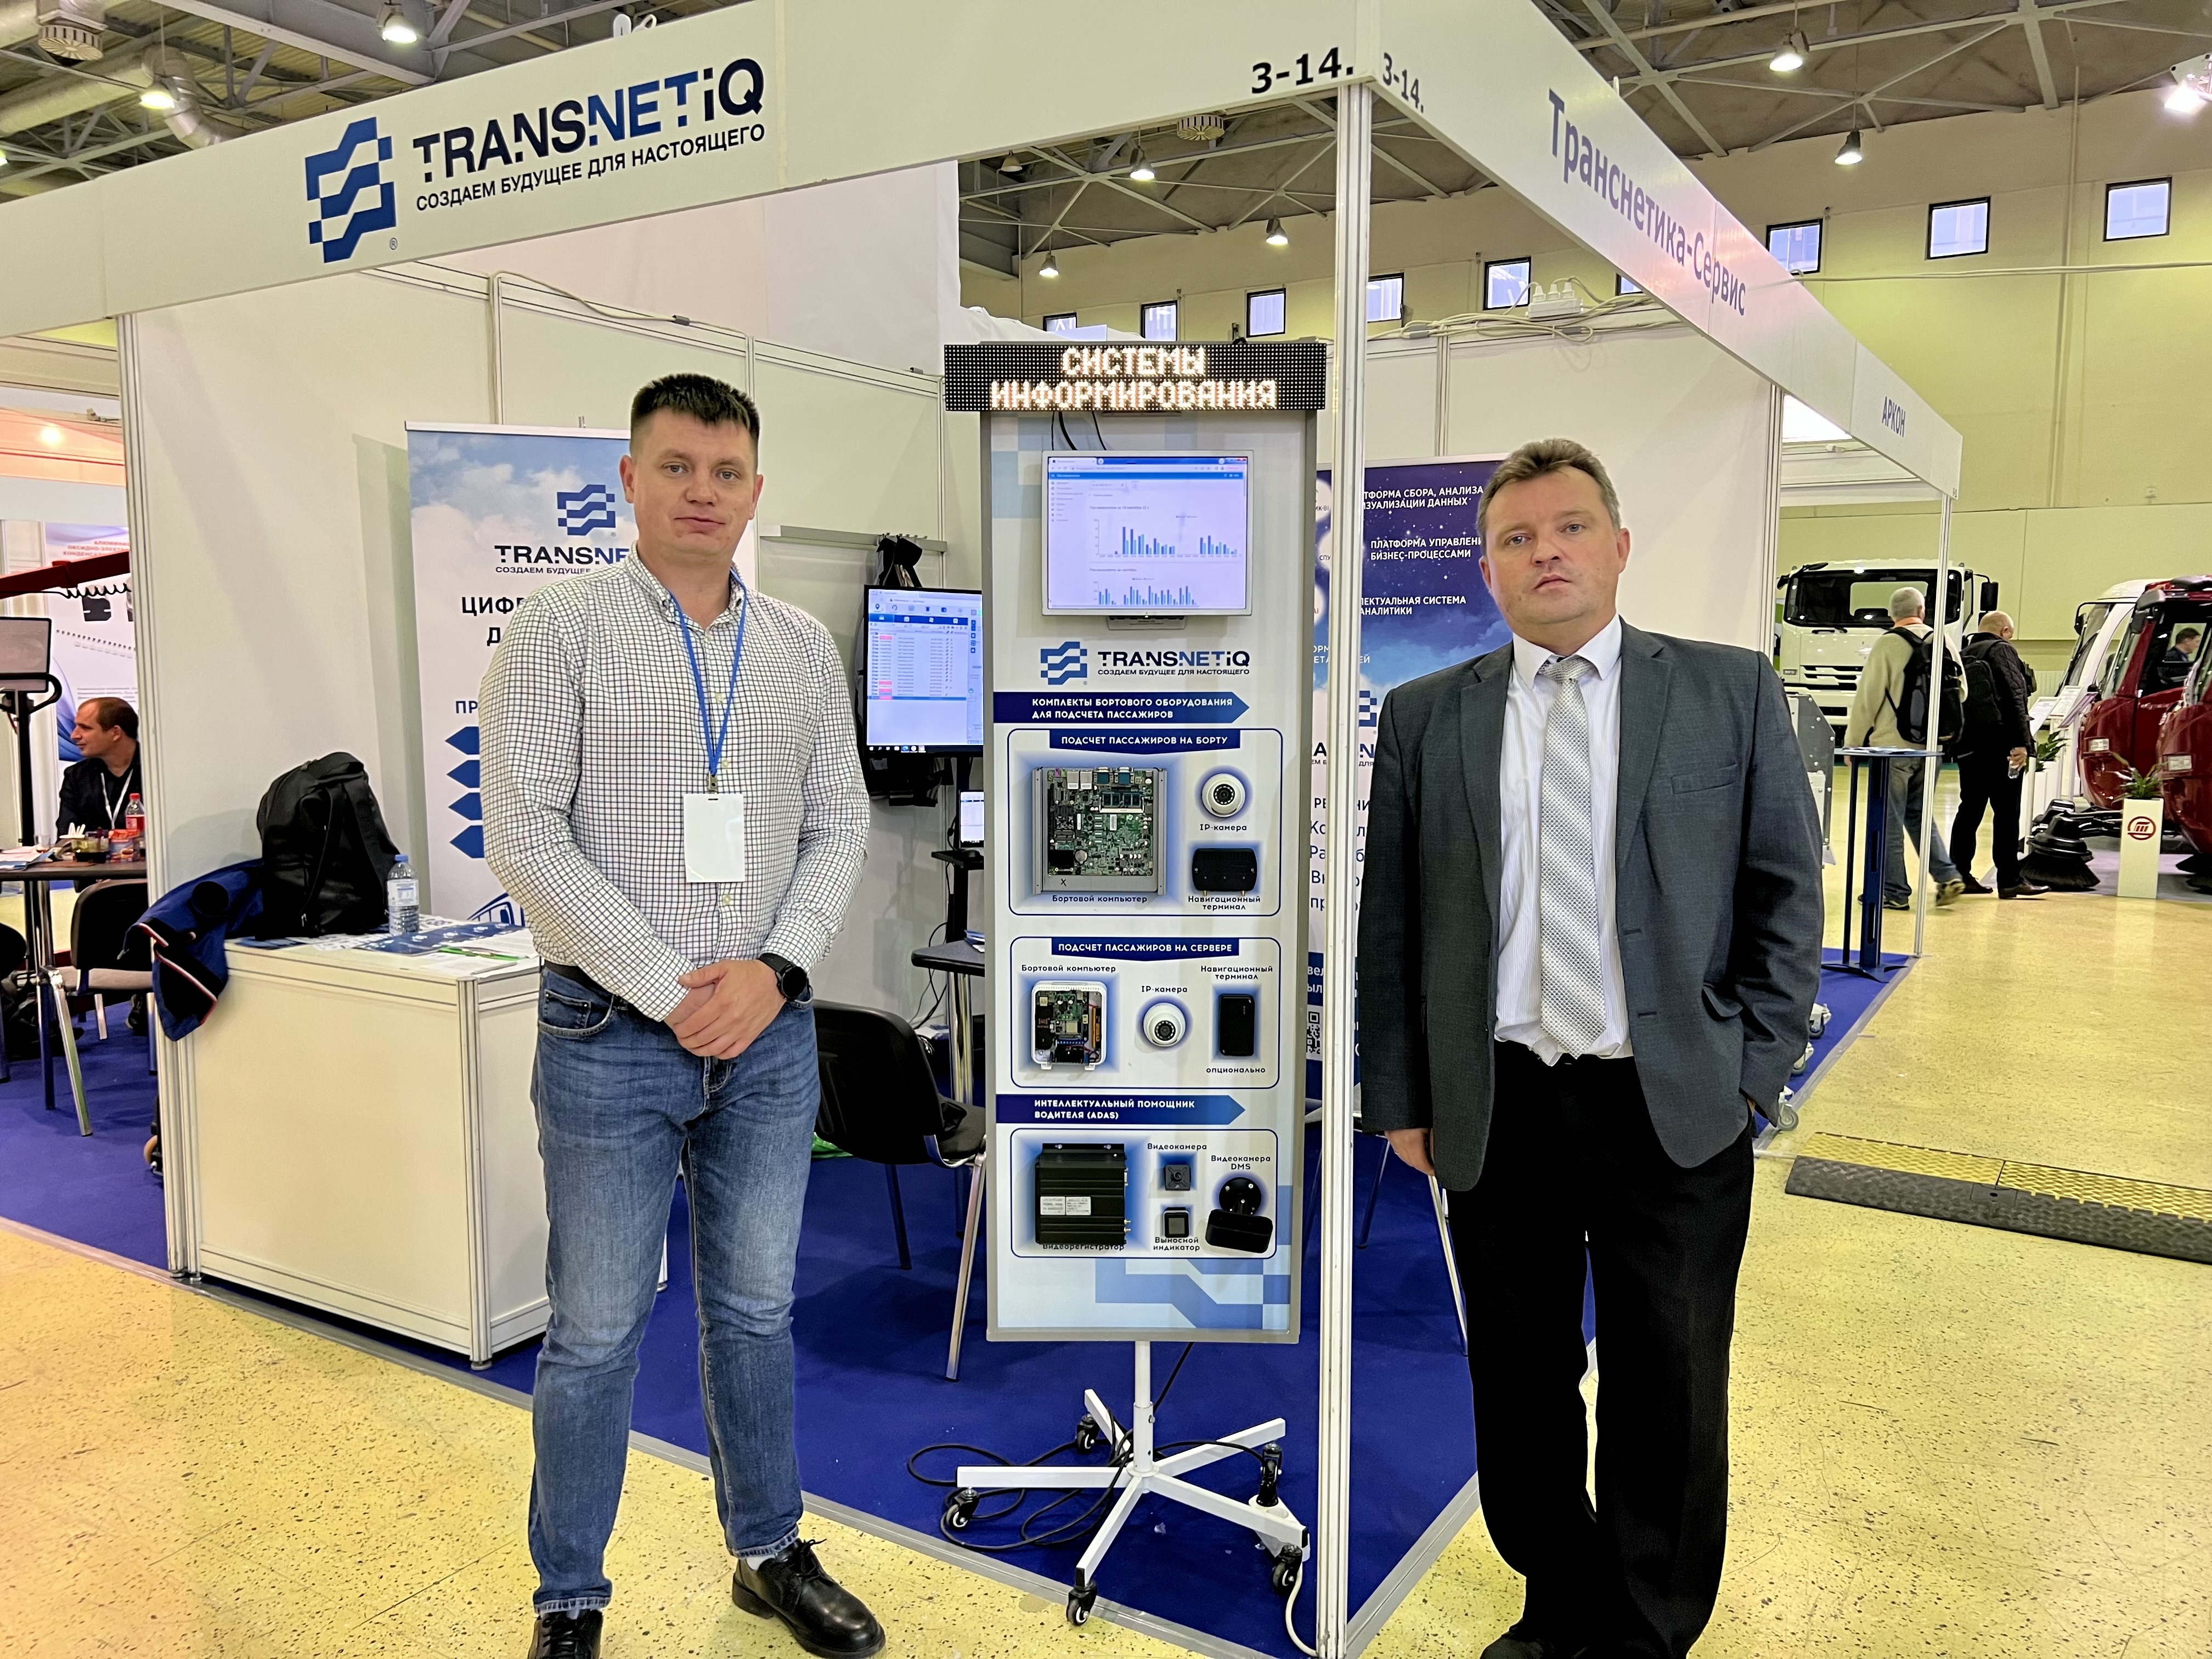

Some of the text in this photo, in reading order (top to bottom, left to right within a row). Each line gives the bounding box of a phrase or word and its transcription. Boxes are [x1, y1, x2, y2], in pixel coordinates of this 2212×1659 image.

[1251, 47, 1354, 94] 3-14.
[1383, 53, 1424, 113] 3-14.
[416, 123, 765, 212] СОЗДАЕМ БУДУЩЕЕ ДЛЯ НАСТОЯЩЕГО
[1549, 89, 1746, 316] Транснетика-Сервис
[1062, 347, 1205, 375] СИСТЕМЫ
[991, 381, 1277, 409] ИНФОРМИРОВАНИЯ
[1882, 396, 1905, 438] АРКОН
[1404, 488, 1436, 498] СБОРА,
[1439, 486, 1483, 495] АНАЛИЗА
[1427, 497, 1468, 507] ДАННЫХ
[1371, 540, 1426, 549] ПЛАТФОРМА
[1371, 550, 1471, 560] БИЗНЕС-ПРОЦЕССАМИ
[1423, 596, 1466, 605] СИСТЕМА
[1032, 698, 1092, 707] КОМПЛЕКТЫ
[1155, 698, 1233, 707] ОБОРУДОВАНИЯ
[1032, 710, 1173, 719] ДЛЯ ПОДСЧЕТА ПАССАЖИРОВ
[1062, 736, 1228, 745] ПОДСЧЕТ ПАССАЖИРОВ НА БОРТУ
[1052, 895, 1094, 903] Бортовой
[1188, 895, 1261, 904] Навигационный
[1058, 944, 1232, 952] ПОДСЧЕТ ПАССАЖИРОВ НА СЕРВЕРЕ
[1201, 965, 1273, 973] Навигационный
[1034, 1099, 1195, 1109] ИНТЕЛЛЕКТУАЛЬНЫЙ ПОМОЩНИК
[1034, 1111, 1119, 1120] ВОДИТЕЛЯ (ADAS)
[1147, 1143, 1207, 1151] Видеокамера
[1153, 1244, 1200, 1252] индикатор
